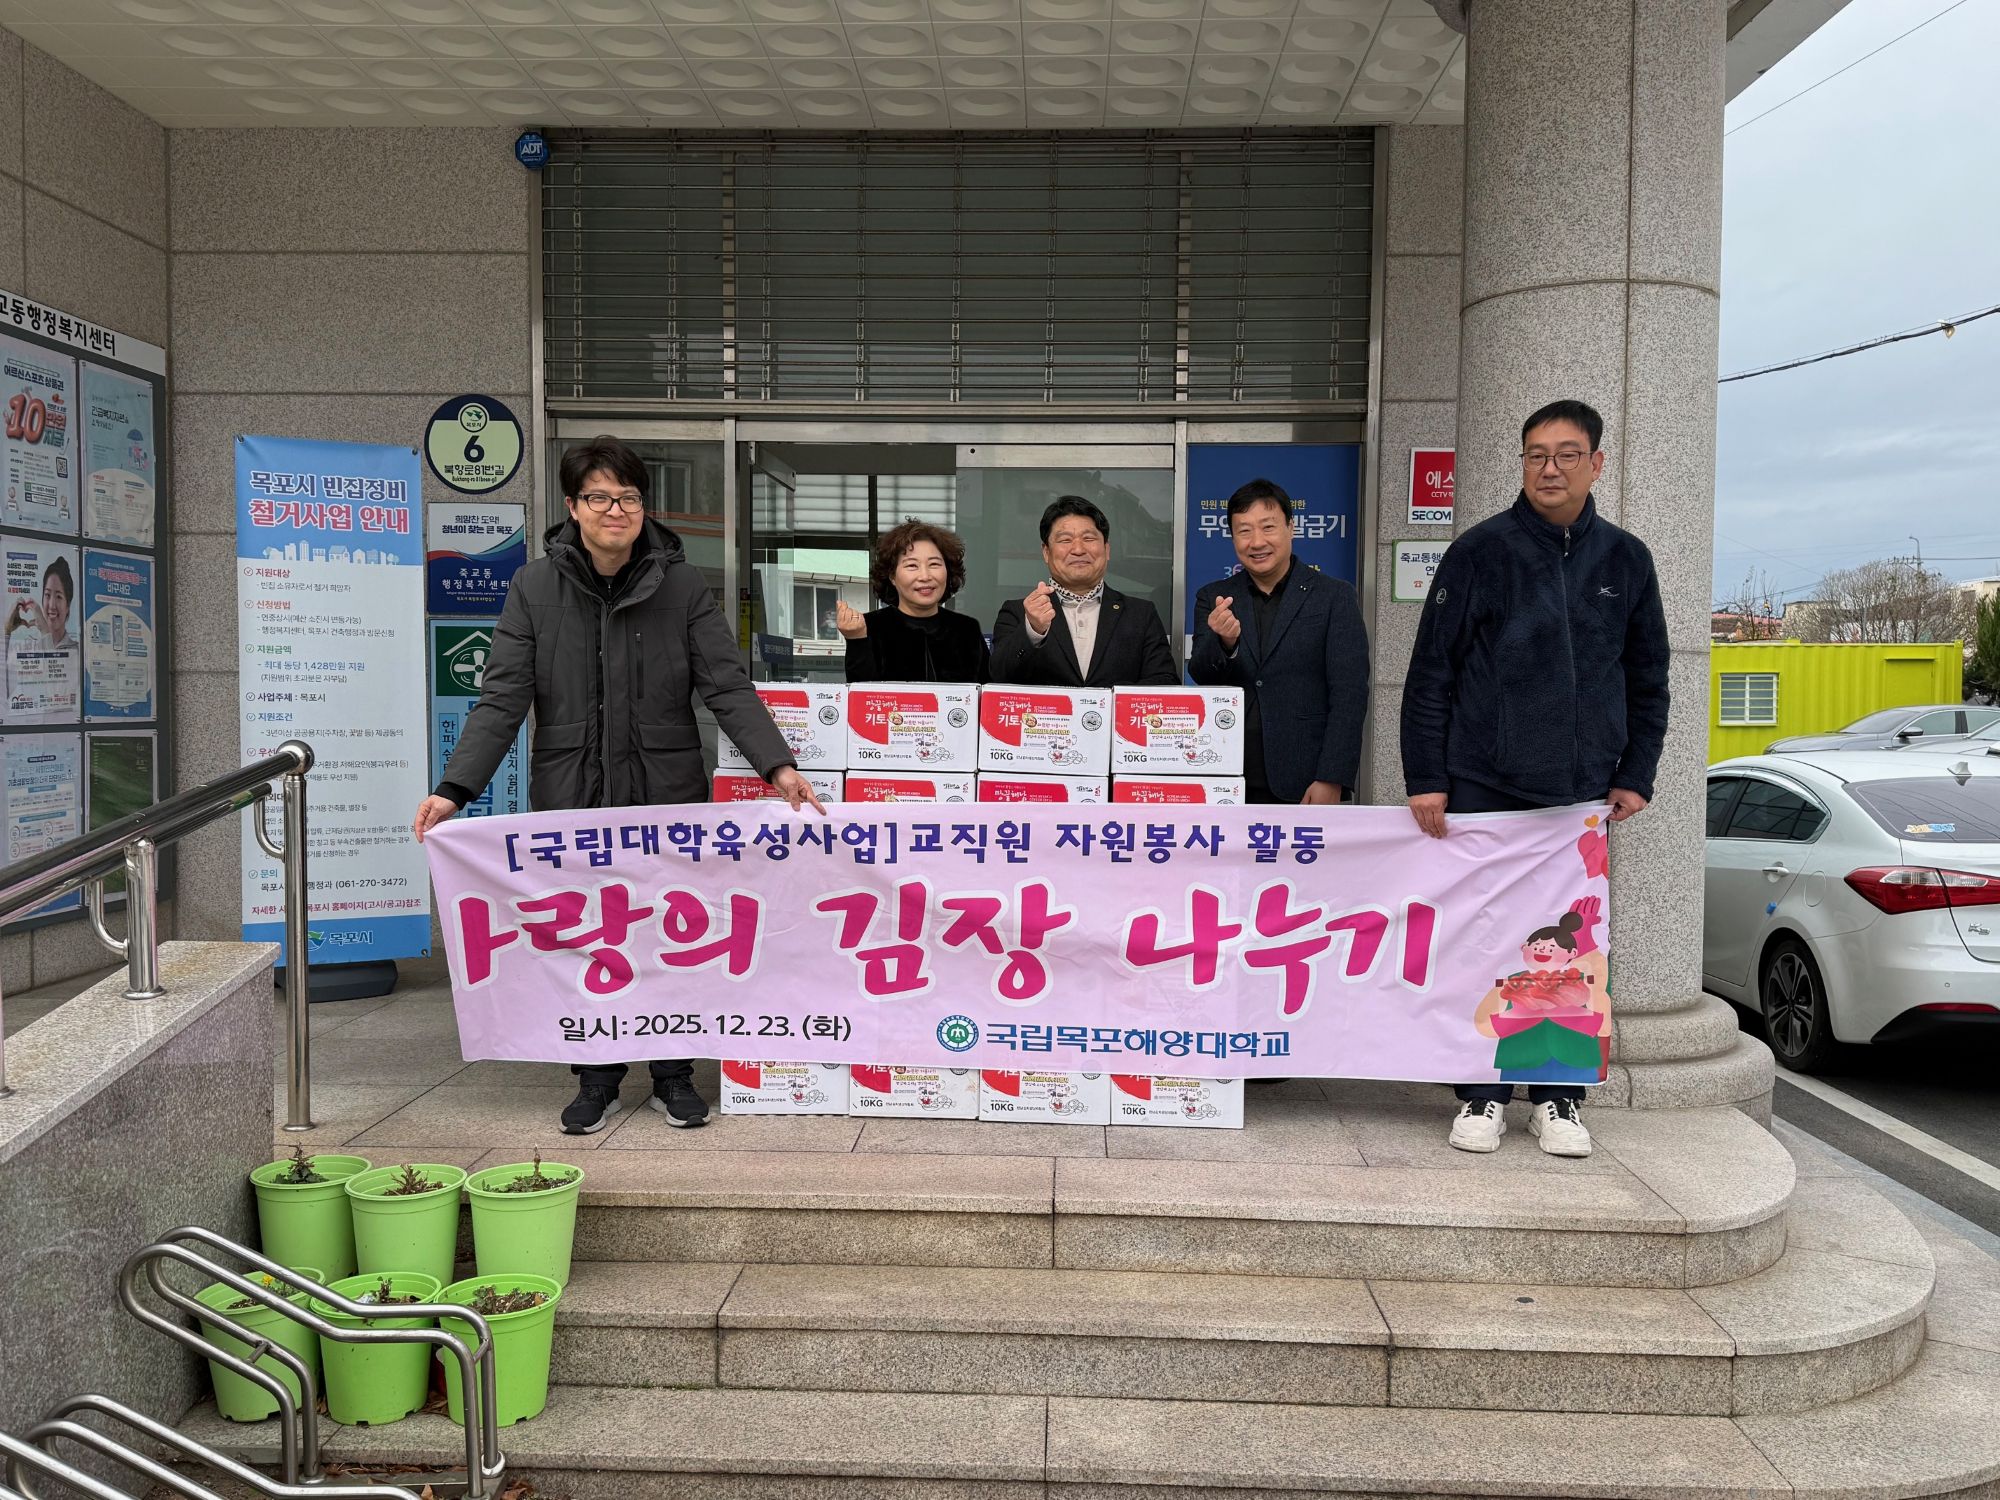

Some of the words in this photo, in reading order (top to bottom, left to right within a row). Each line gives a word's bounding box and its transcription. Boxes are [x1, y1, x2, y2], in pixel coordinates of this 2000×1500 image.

[521, 142, 542, 154] ADT
[6, 394, 46, 444] 10
[464, 435, 484, 462] 6
[444, 464, 504, 476] 북항로81번길
[250, 470, 316, 497] 목포시
[322, 476, 407, 502] 빈집정비
[249, 500, 352, 530] 철거사업
[359, 507, 409, 534] 안내
[455, 515, 480, 524] 희망찬
[1412, 511, 1452, 520] SECOM
[442, 525, 466, 534] 청년이
[468, 525, 484, 534] 찾는
[486, 526, 494, 534] 큰
[496, 526, 512, 535] 목포
[256, 568, 290, 578] 지원대상
[459, 568, 492, 579] 죽교동
[442, 580, 510, 590] 행정복지센터
[256, 600, 290, 610] 신청방법
[257, 644, 292, 654] 지원금액
[304, 662, 346, 672] 1,428만원
[348, 662, 365, 672] 지원
[258, 692, 292, 702] 사업주체
[300, 692, 326, 702] 목포시
[258, 712, 293, 722] 지원조건
[858, 751, 882, 759] 10KG
[990, 752, 1014, 760] 10KG
[1124, 754, 1147, 762] 10KG
[1055, 820, 1225, 864] 자원봉사
[1247, 822, 1326, 865] 활동
[260, 868, 278, 878] 문의
[336, 878, 408, 890] (061-270-3472)
[252, 906, 276, 915] 자세한
[329, 931, 374, 946] 목포시
[817, 883, 1071, 999] 김장
[1126, 885, 1435, 1014] 나누기
[634, 1014, 708, 1036] 2025.
[986, 1023, 1291, 1059] 국립목포해양대학교
[990, 1104, 1014, 1112] 10KG
[1122, 1107, 1146, 1115] 10KG
